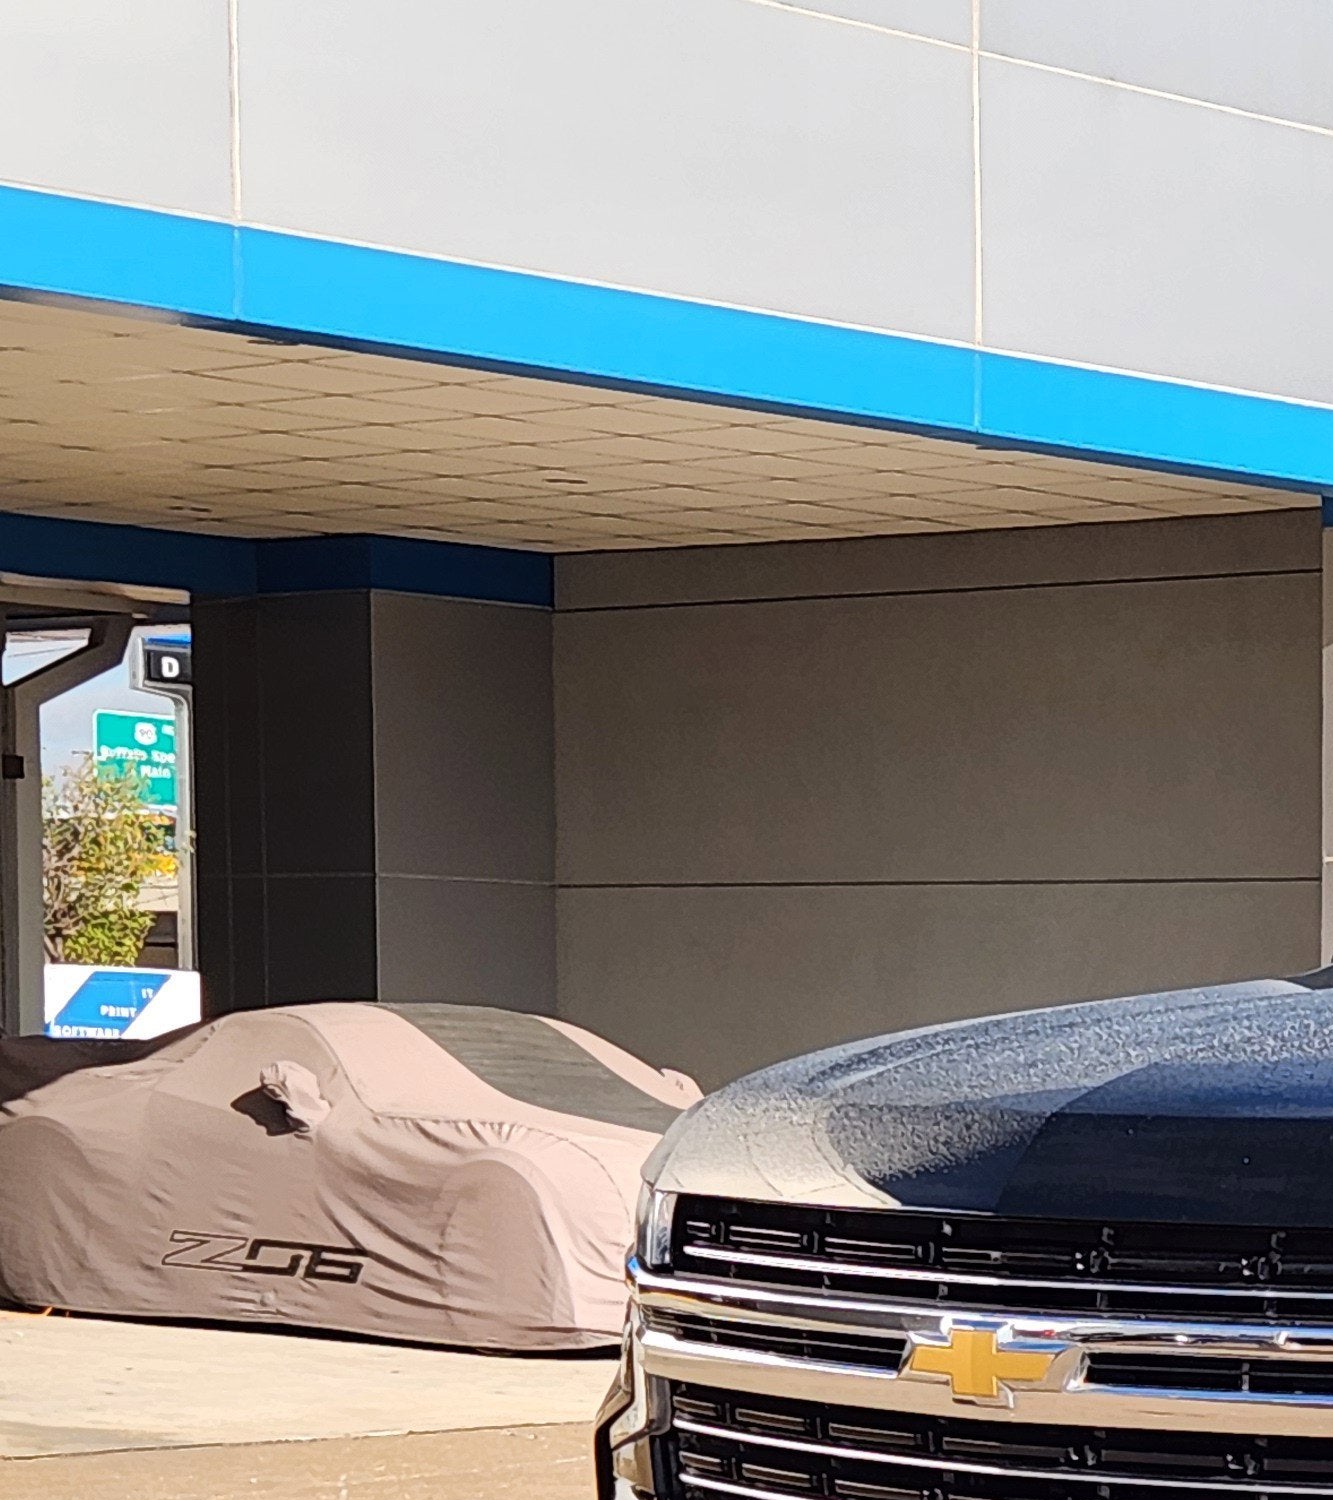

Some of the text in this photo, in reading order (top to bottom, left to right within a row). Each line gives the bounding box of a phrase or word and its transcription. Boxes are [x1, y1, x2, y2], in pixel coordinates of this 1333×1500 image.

[161, 655, 180, 678] D
[100, 1004, 137, 1018] PRINT
[161, 1229, 368, 1284] Z06
